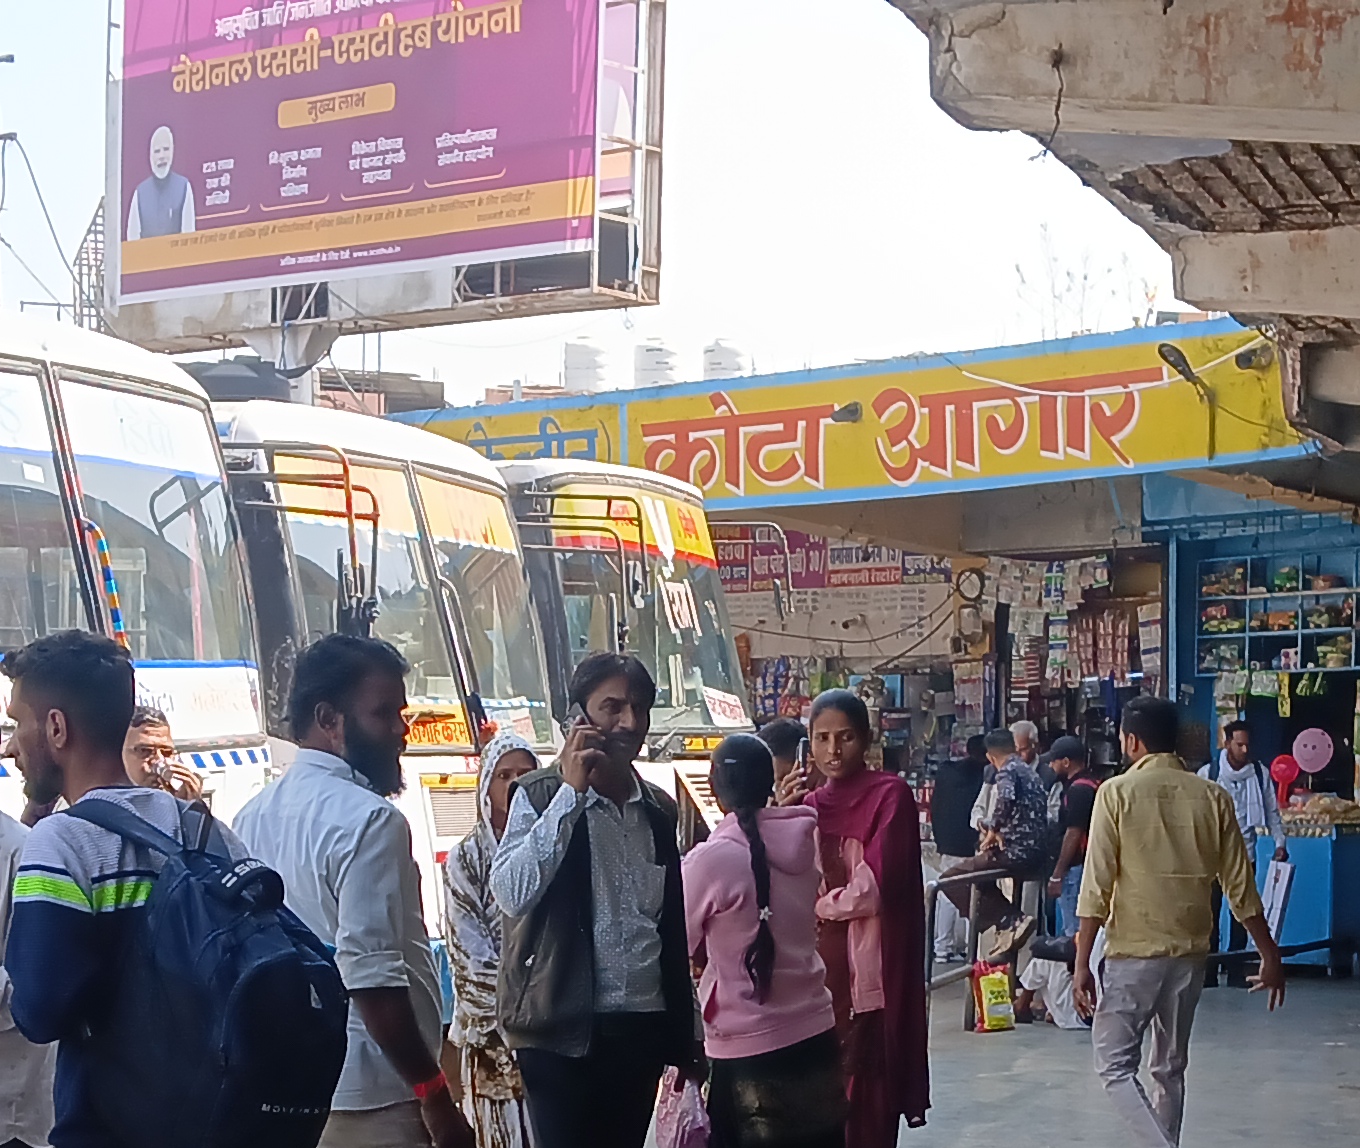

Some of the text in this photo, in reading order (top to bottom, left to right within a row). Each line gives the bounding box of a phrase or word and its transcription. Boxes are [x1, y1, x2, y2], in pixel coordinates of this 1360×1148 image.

[171, 0, 523, 93] नेशनल एससी-एसटी हब योजना
[307, 90, 367, 121] मुख्य लाभ
[640, 365, 1169, 496] कोटा आगार
